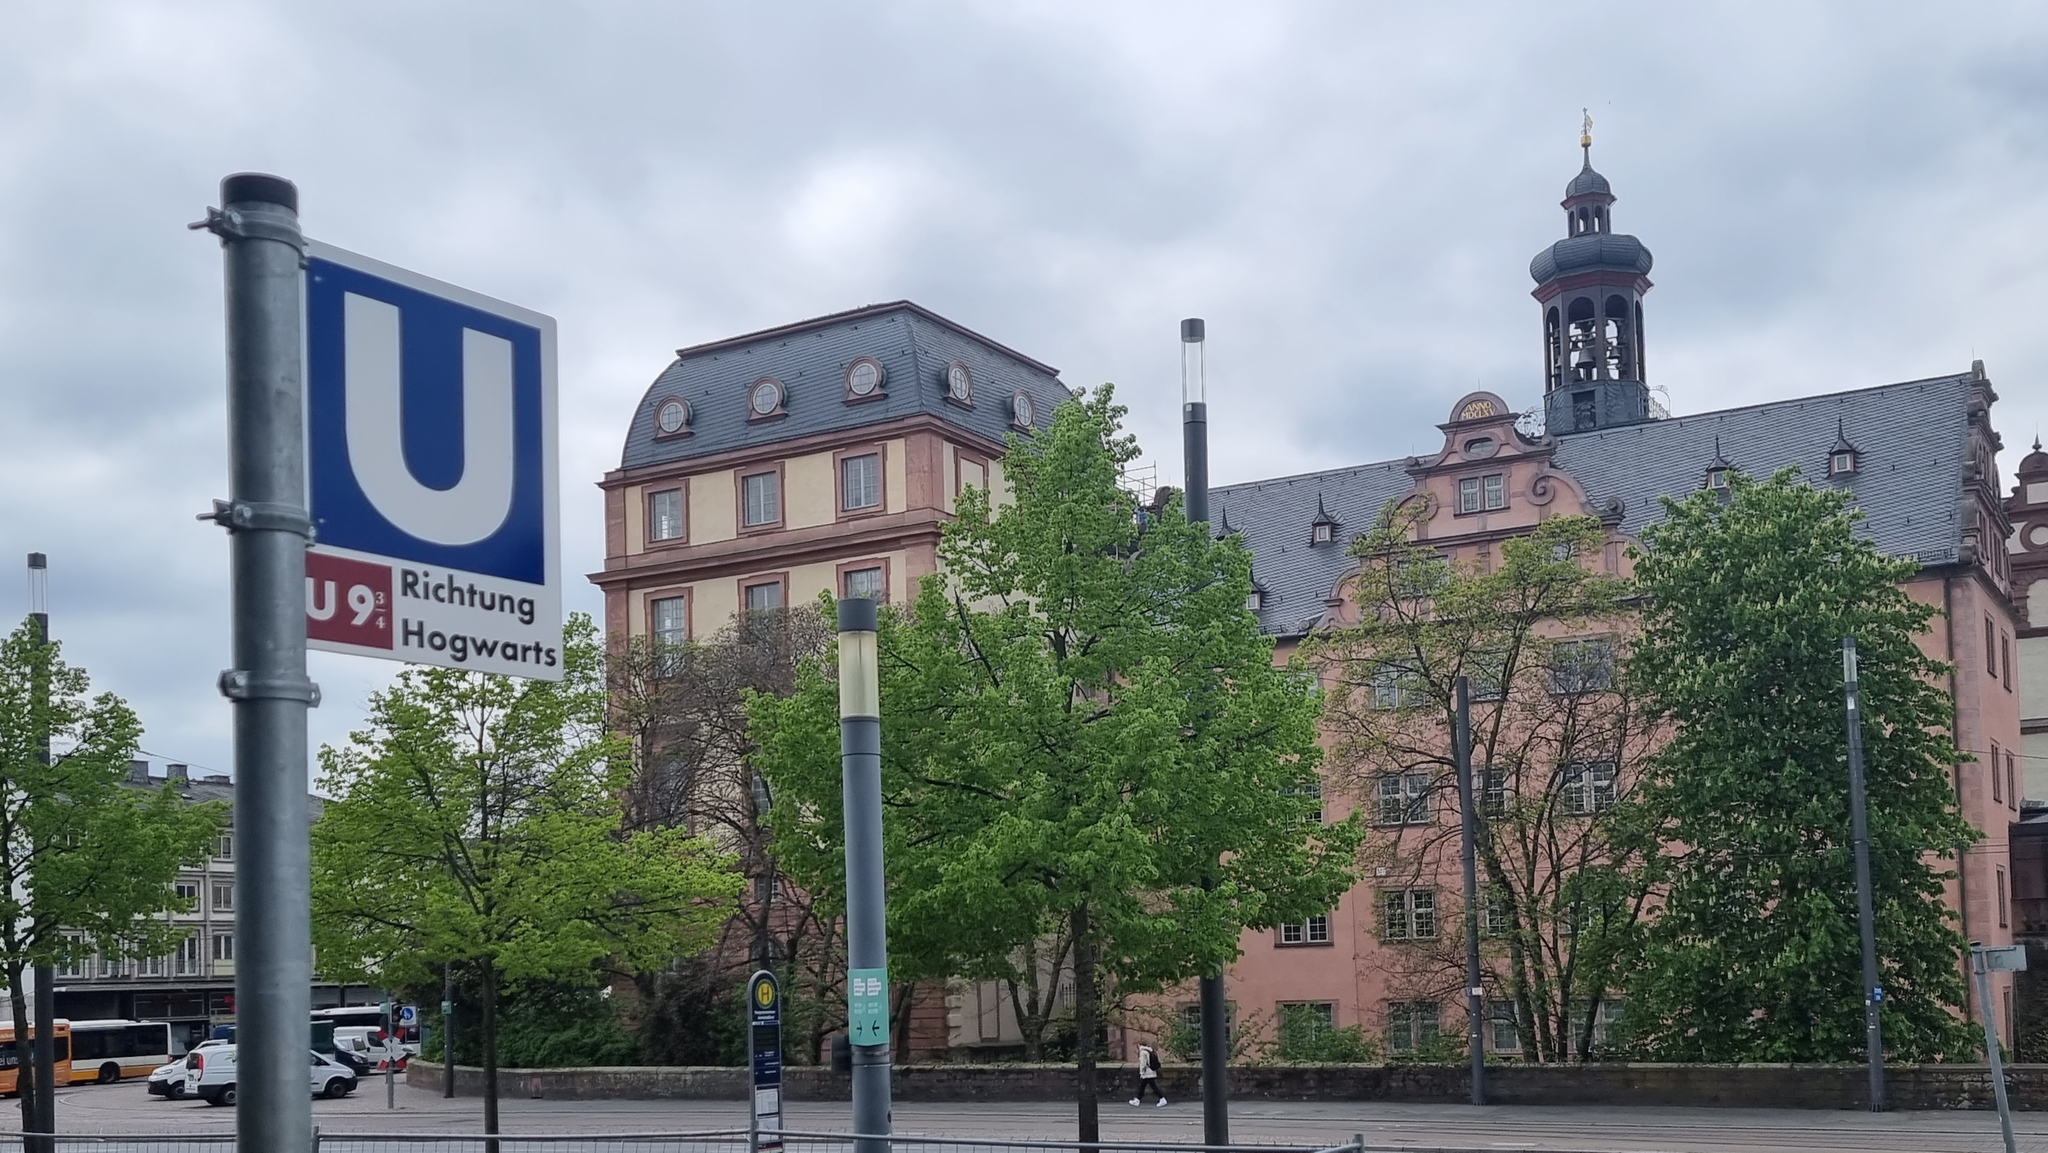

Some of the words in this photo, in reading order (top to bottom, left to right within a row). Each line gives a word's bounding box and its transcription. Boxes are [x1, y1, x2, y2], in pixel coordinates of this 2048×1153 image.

[344, 291, 514, 545] U
[1465, 401, 1492, 411] ANNO
[306, 577, 335, 620] U
[401, 568, 535, 625] Richtung
[402, 617, 556, 667] Hogwarts
[760, 985, 770, 1002] H
